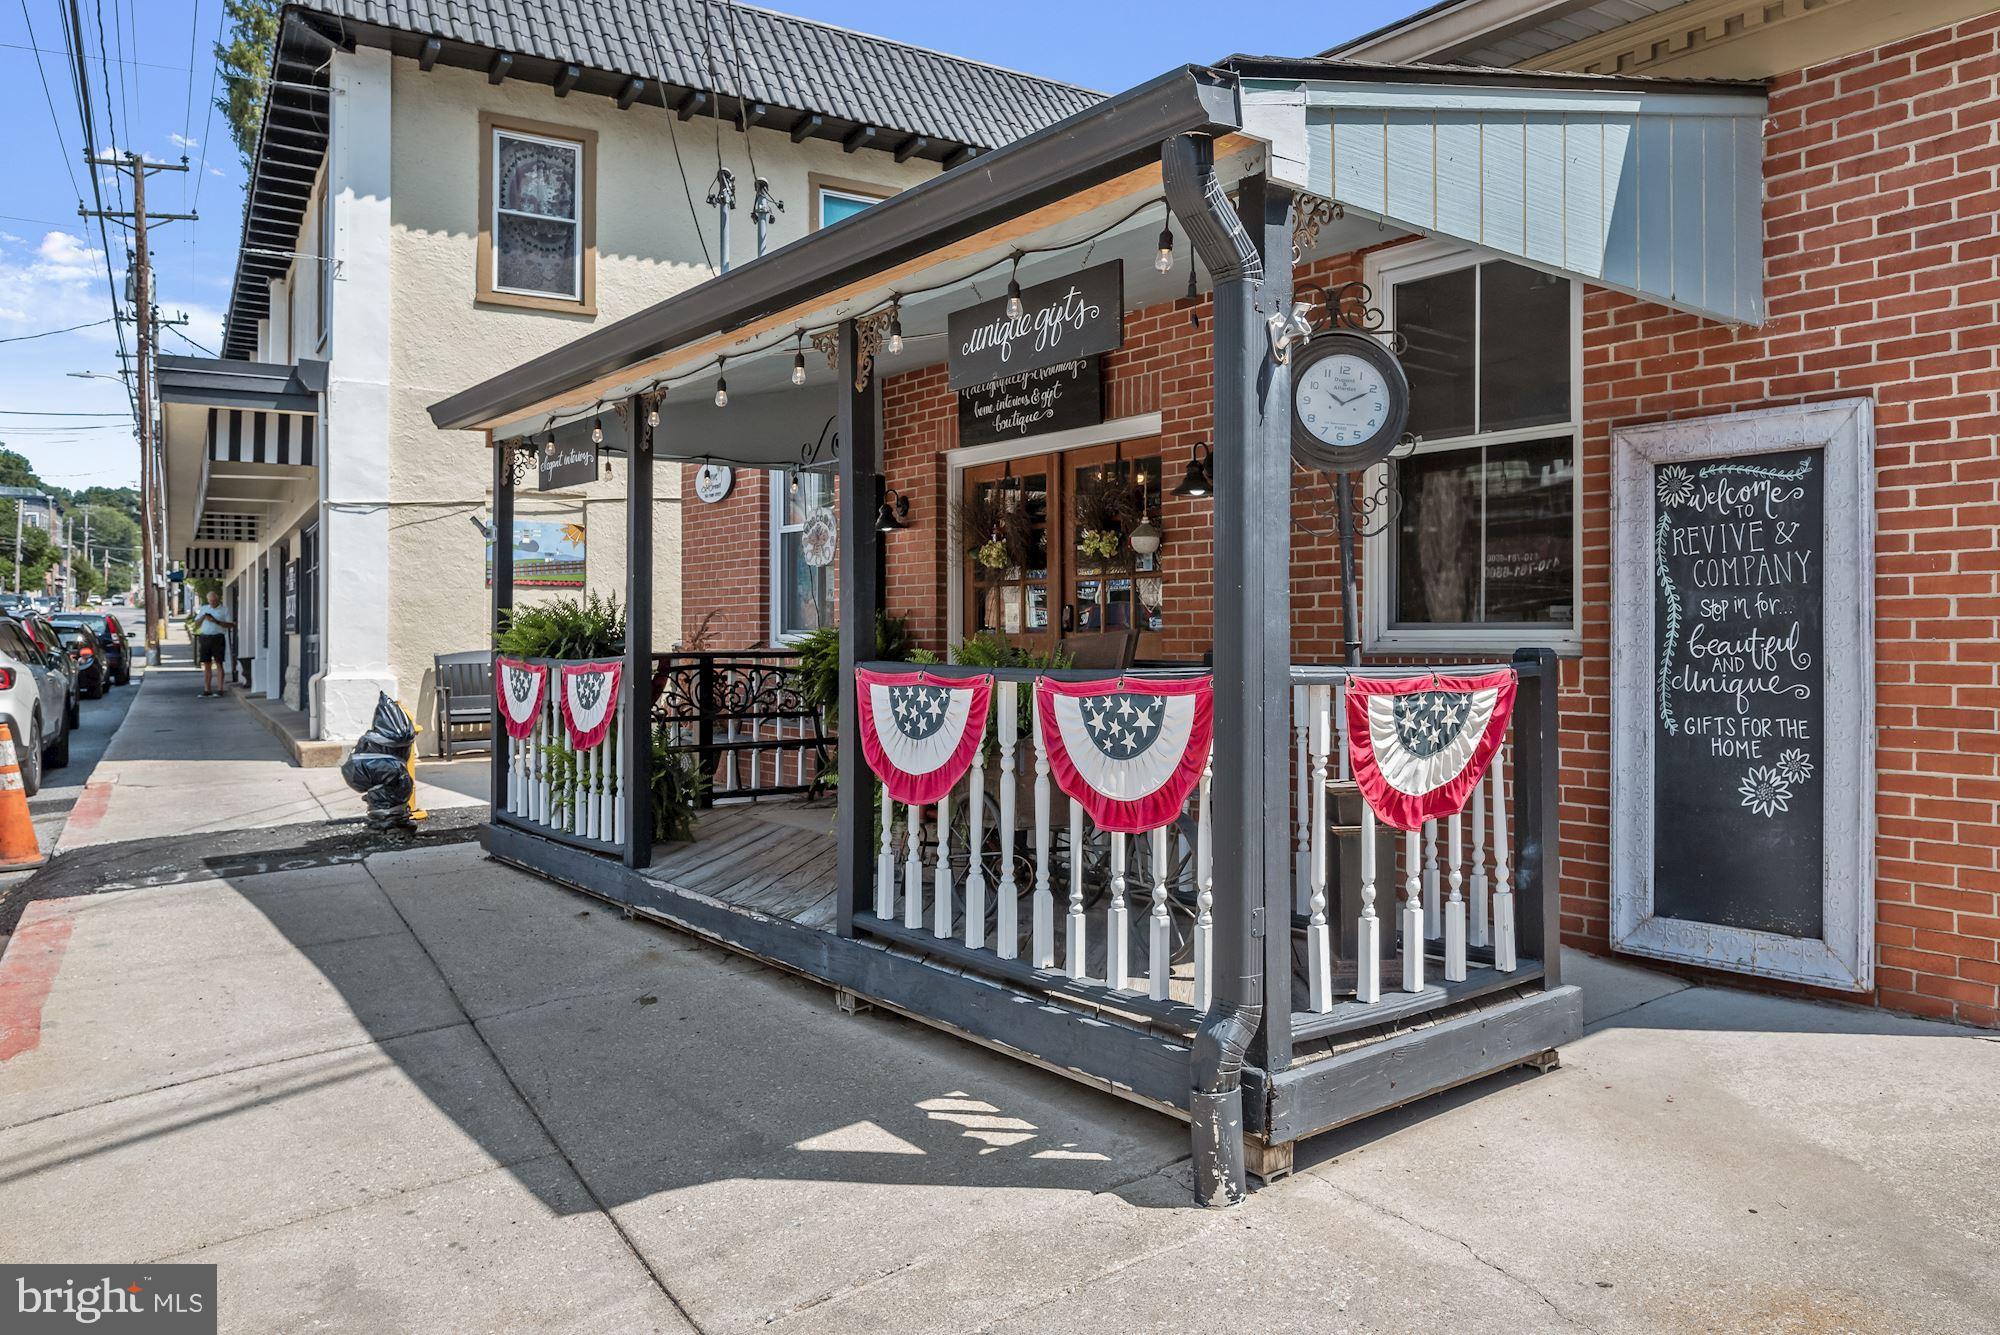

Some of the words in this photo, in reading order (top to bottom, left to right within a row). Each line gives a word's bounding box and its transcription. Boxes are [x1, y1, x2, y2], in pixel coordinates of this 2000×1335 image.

[1034, 286, 1099, 351] gifts
[1324, 369, 1331, 378] 11
[1340, 365, 1351, 375] 12
[1359, 372, 1363, 381] 1
[1310, 381, 1319, 390] 10
[1369, 384, 1378, 394] 2
[974, 401, 995, 418] home
[1031, 387, 1041, 405] &
[1041, 380, 1062, 408] gift
[1303, 396, 1311, 405] 9
[1374, 402, 1382, 412] 3
[992, 409, 1054, 434] boutique
[1307, 414, 1316, 423] 8
[1367, 419, 1376, 427] 4
[1321, 426, 1329, 435] 7
[1353, 430, 1361, 440] 5
[1336, 432, 1344, 441] 6
[1734, 503, 1755, 518] TO
[1672, 520, 1765, 556] REVIVE
[1774, 521, 1800, 545] &
[1693, 550, 1812, 588] COMPANY
[1734, 596, 1751, 619] in
[1687, 621, 1811, 671] beautiful
[1711, 657, 1745, 672] AND
[1684, 717, 1736, 736] GIFTS
[1741, 717, 1772, 737] FOR
[1776, 718, 1810, 739] THE
[1711, 738, 1763, 759] HOME
